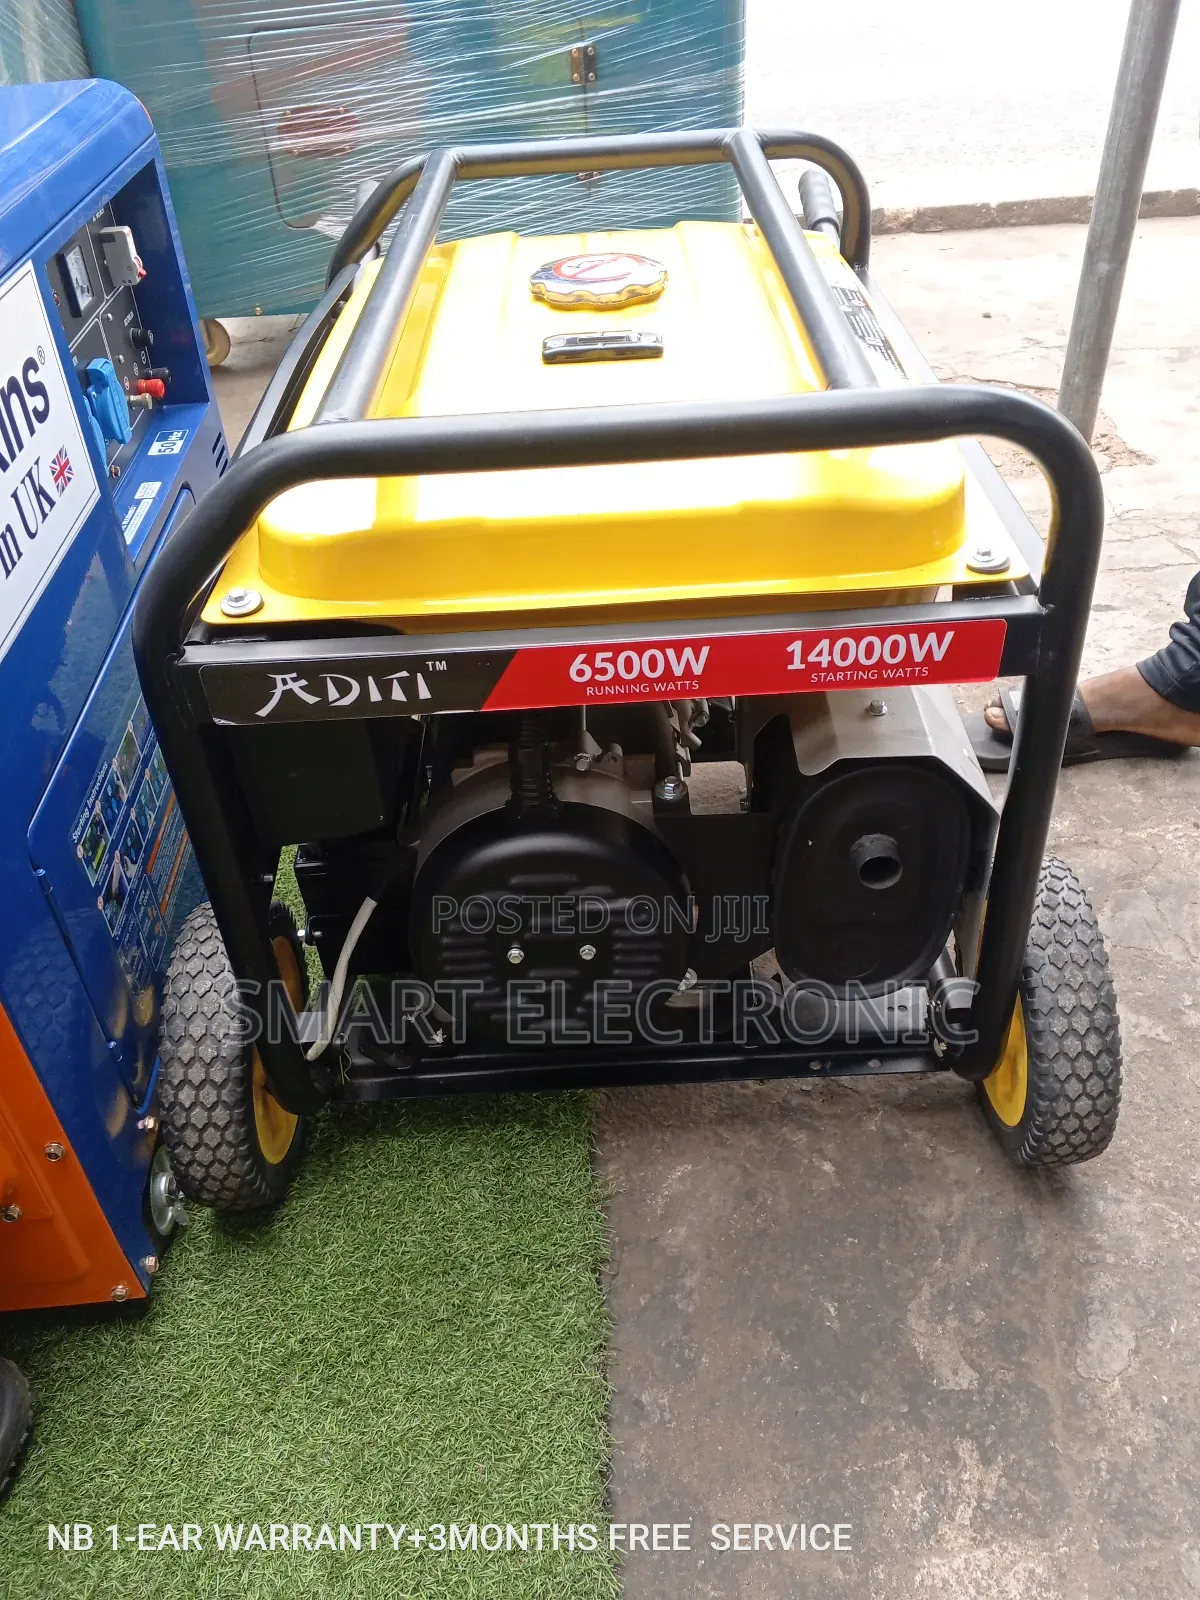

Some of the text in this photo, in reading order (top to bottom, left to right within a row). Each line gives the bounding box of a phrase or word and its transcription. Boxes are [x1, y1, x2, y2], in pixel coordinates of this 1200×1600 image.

[157, 441, 178, 454] 50
[10, 455, 57, 540] UK
[569, 645, 711, 683] 6500W
[786, 630, 955, 671] 14000W
[586, 679, 699, 696] RUNNING WATTS
[810, 666, 929, 683] STARTING WATTS
[254, 671, 432, 718] ADITI
[72, 761, 108, 844] Starting Instructions
